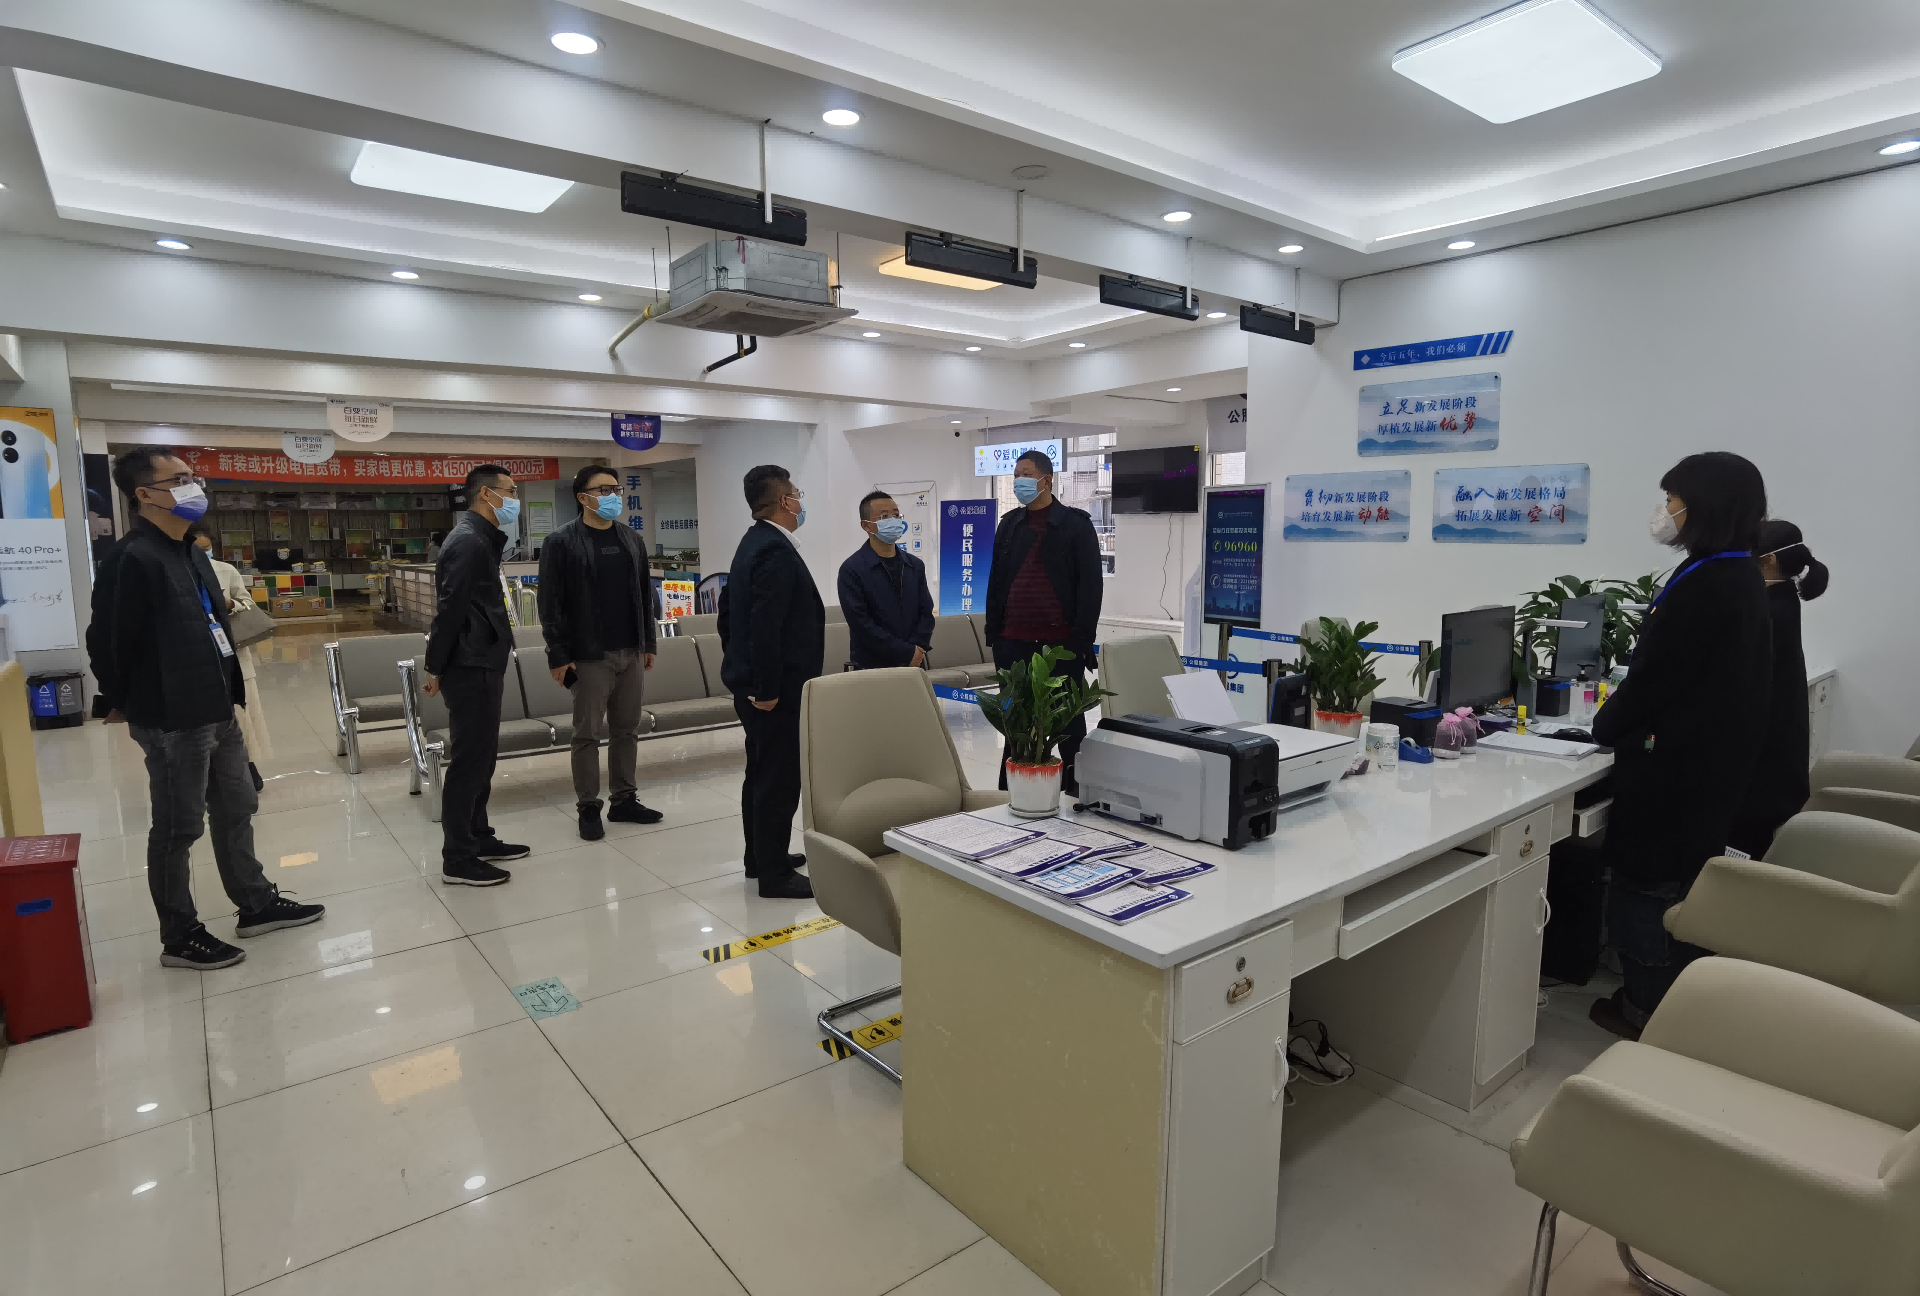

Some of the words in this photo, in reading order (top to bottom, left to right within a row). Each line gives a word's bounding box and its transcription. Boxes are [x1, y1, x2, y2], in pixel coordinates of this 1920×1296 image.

[1380, 342, 1467, 362] 今后五年、我们必须
[1379, 396, 1477, 417] 立足新发展阶段
[1378, 411, 1476, 435] 厚植发展新优势
[1455, 485, 1567, 503] 融入新发展格局
[1300, 506, 1390, 525] 培育发展新动能
[1456, 503, 1566, 524] 拓展发展新空间
[18, 546, 32, 554] 40
[34, 545, 62, 555] Pro+
[1224, 541, 1257, 552] 96960
[961, 523, 974, 612] 便民服务办理
[1226, 681, 1245, 694] 集团
